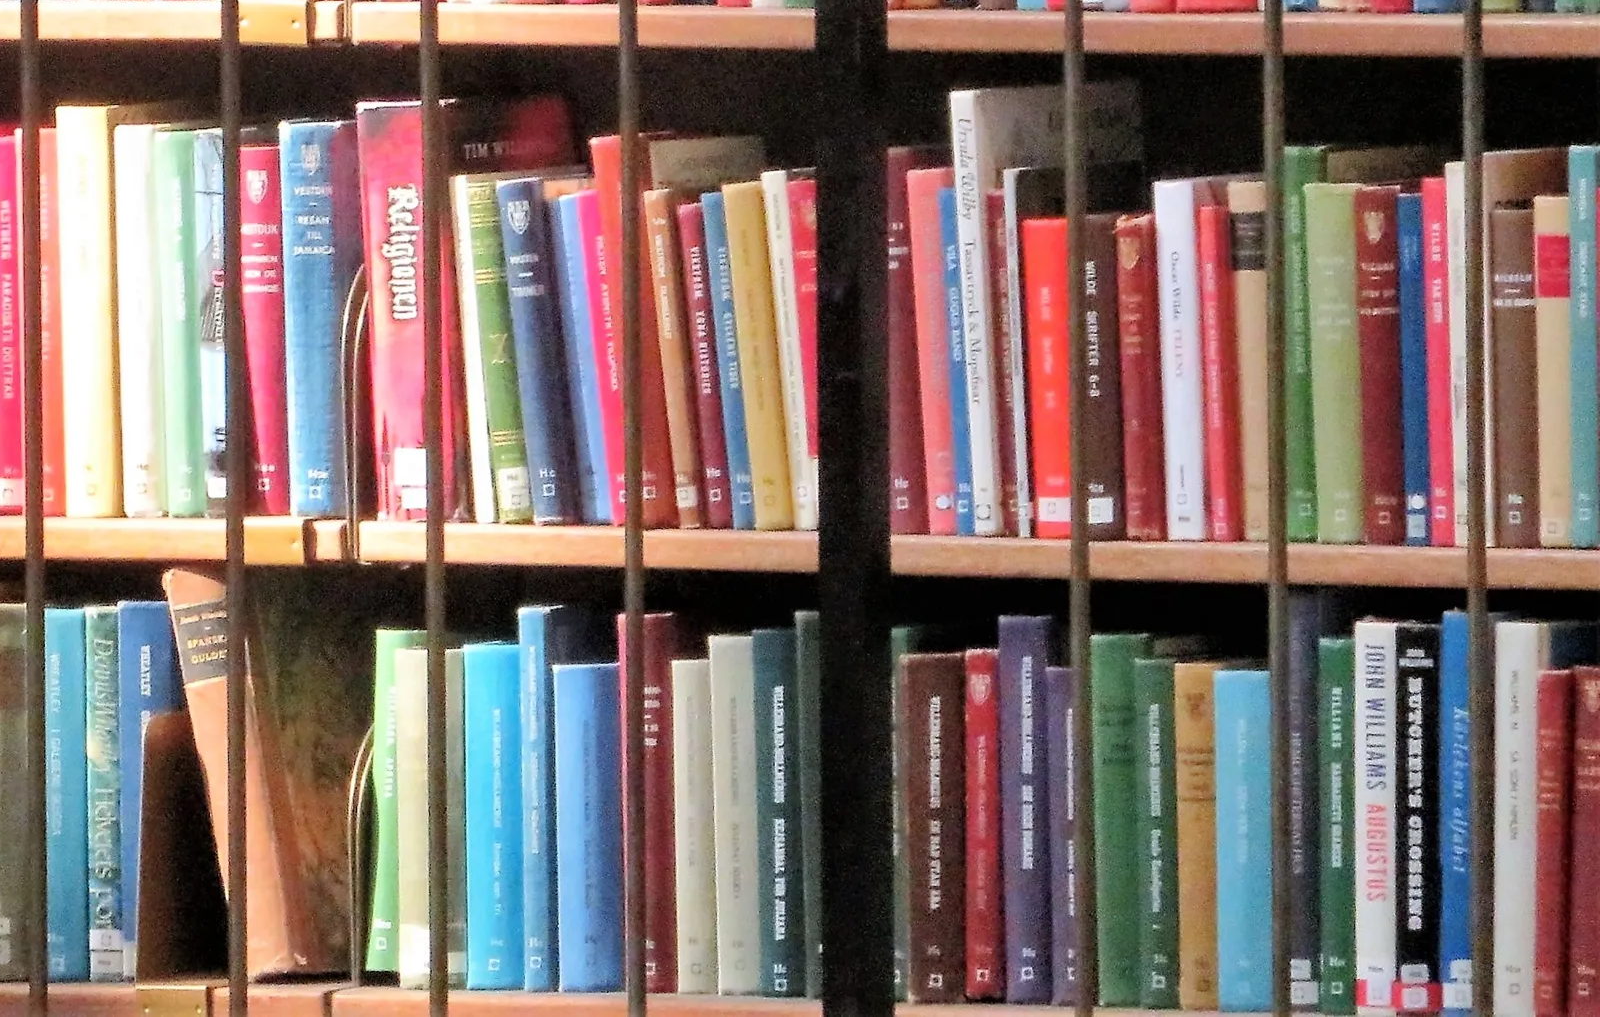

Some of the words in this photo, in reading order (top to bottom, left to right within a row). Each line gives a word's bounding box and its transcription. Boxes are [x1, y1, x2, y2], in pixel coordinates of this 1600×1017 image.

[381, 184, 420, 320] Religionen
[1363, 643, 1387, 689] JOHN
[1364, 697, 1387, 791] WILLIAMS
[1365, 803, 1388, 902] AUGUSTUS
[1407, 815, 1423, 930] CROSSING
